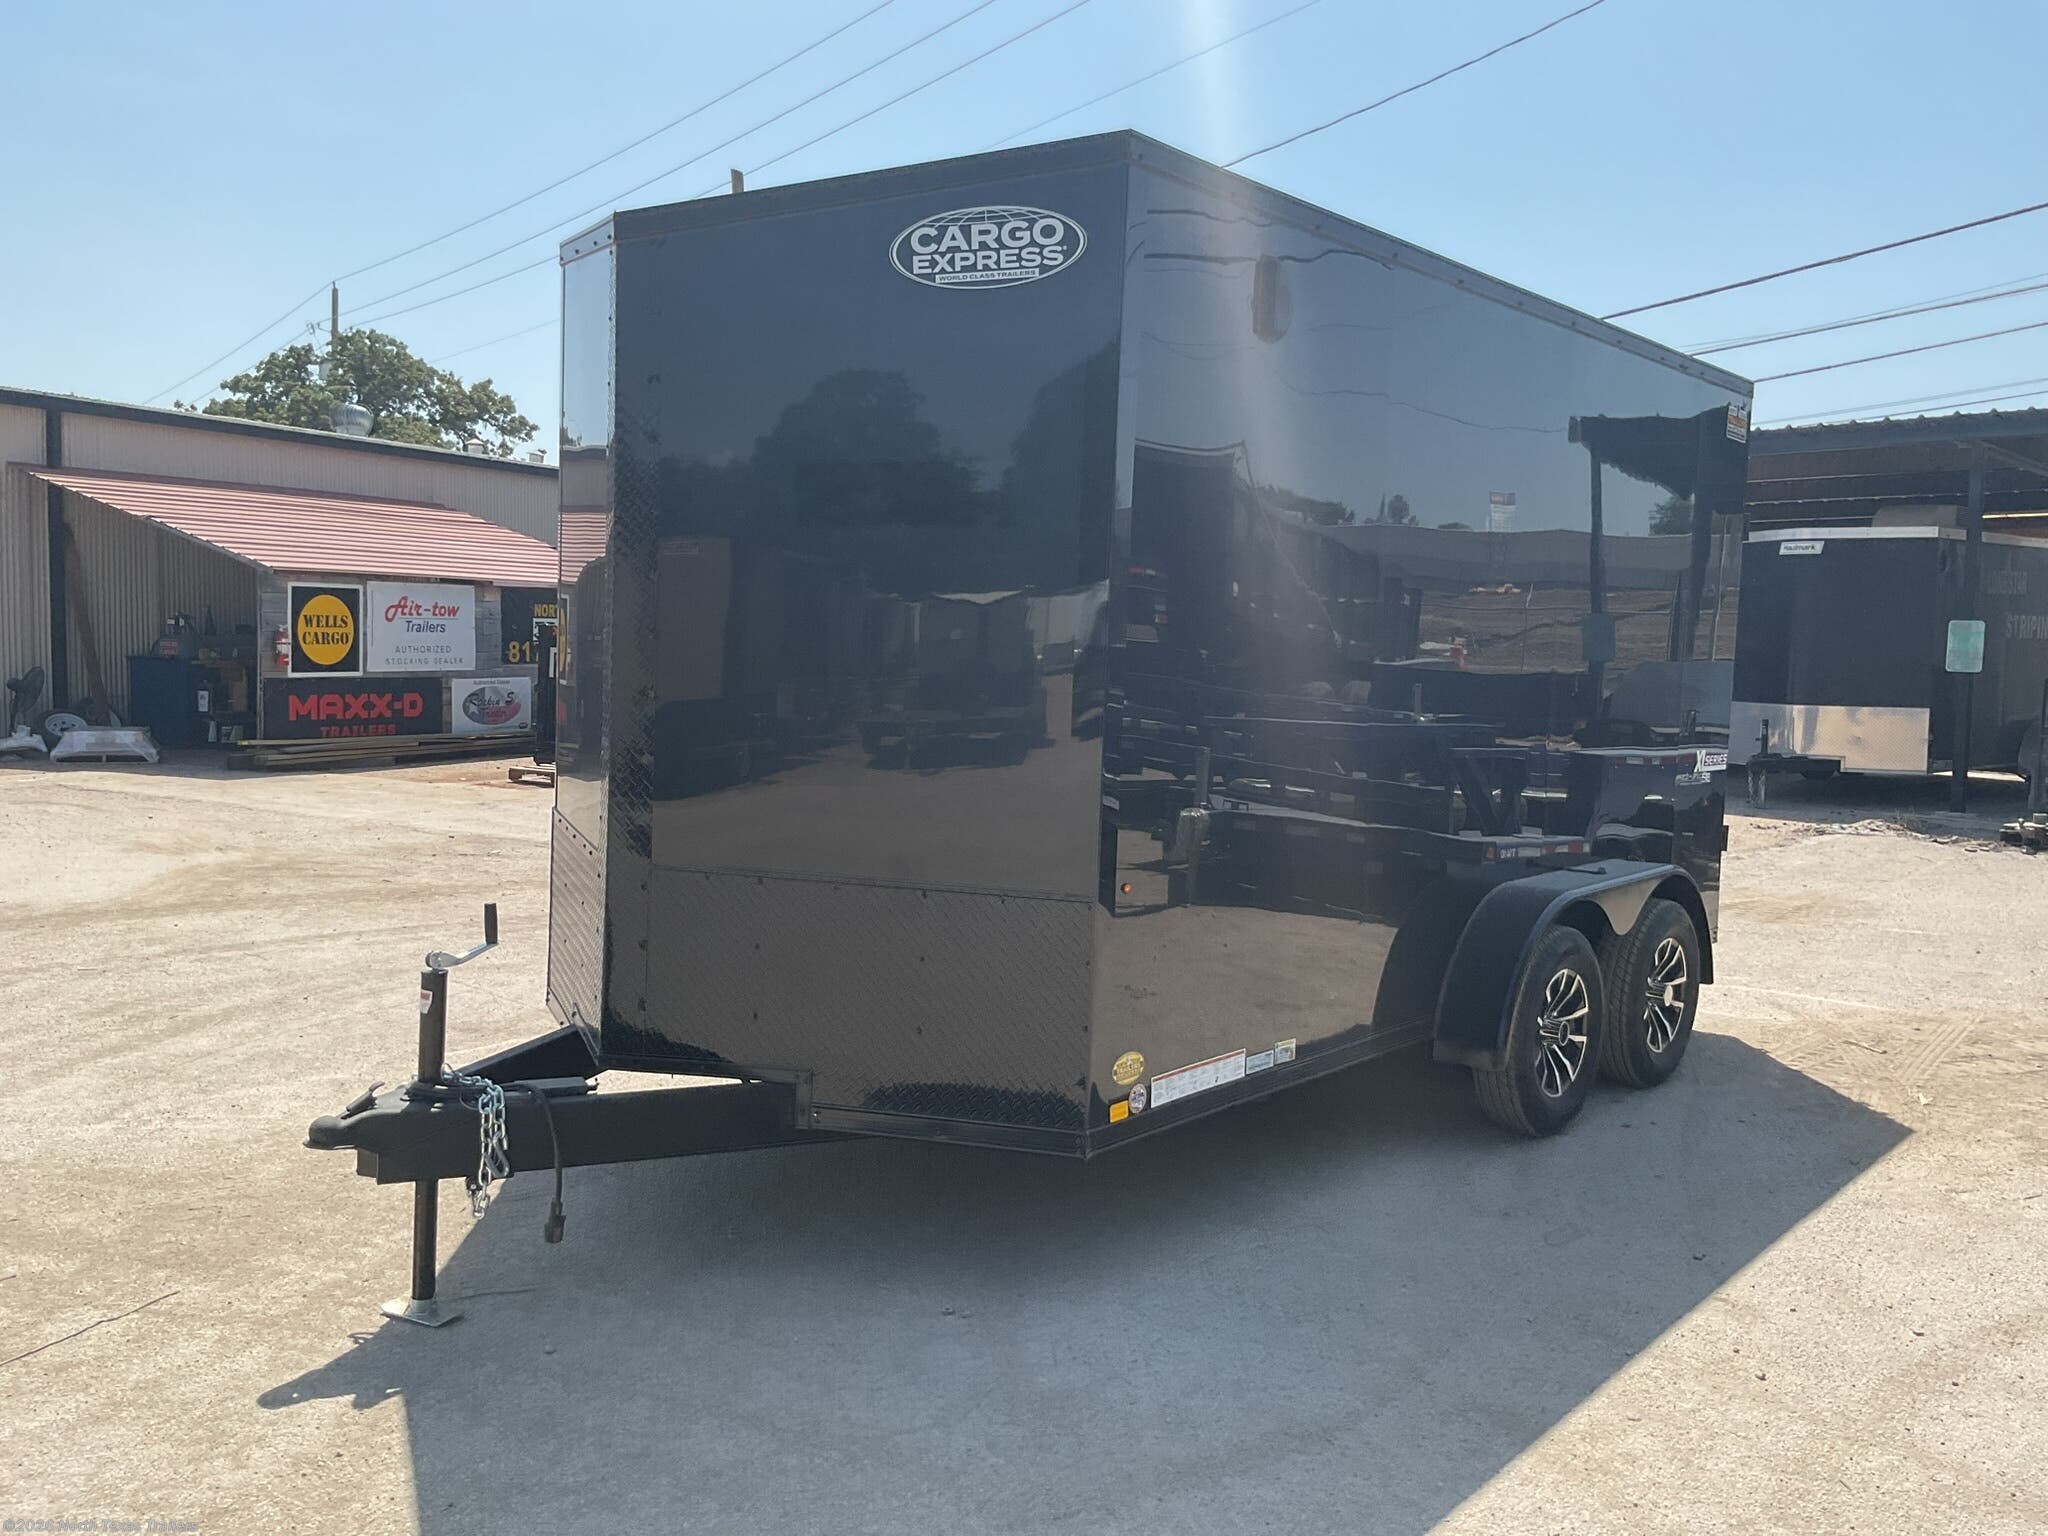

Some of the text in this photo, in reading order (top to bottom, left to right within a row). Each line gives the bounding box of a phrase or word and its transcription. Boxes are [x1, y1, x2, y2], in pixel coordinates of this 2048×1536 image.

[910, 218, 1065, 255] CARGO
[912, 246, 1064, 275] EXPRESS
[939, 269, 1036, 282] WORLD CLASS TRAILERS
[384, 595, 460, 622] Air-tow
[303, 614, 348, 628] WELLS
[406, 620, 446, 633] Trailers
[302, 631, 350, 645] CARGO
[395, 645, 452, 654] AUTHORIZED
[384, 657, 463, 665] STOCKING DEALER
[288, 692, 424, 721] MAXX-D
[320, 724, 396, 738] TRAILERS
